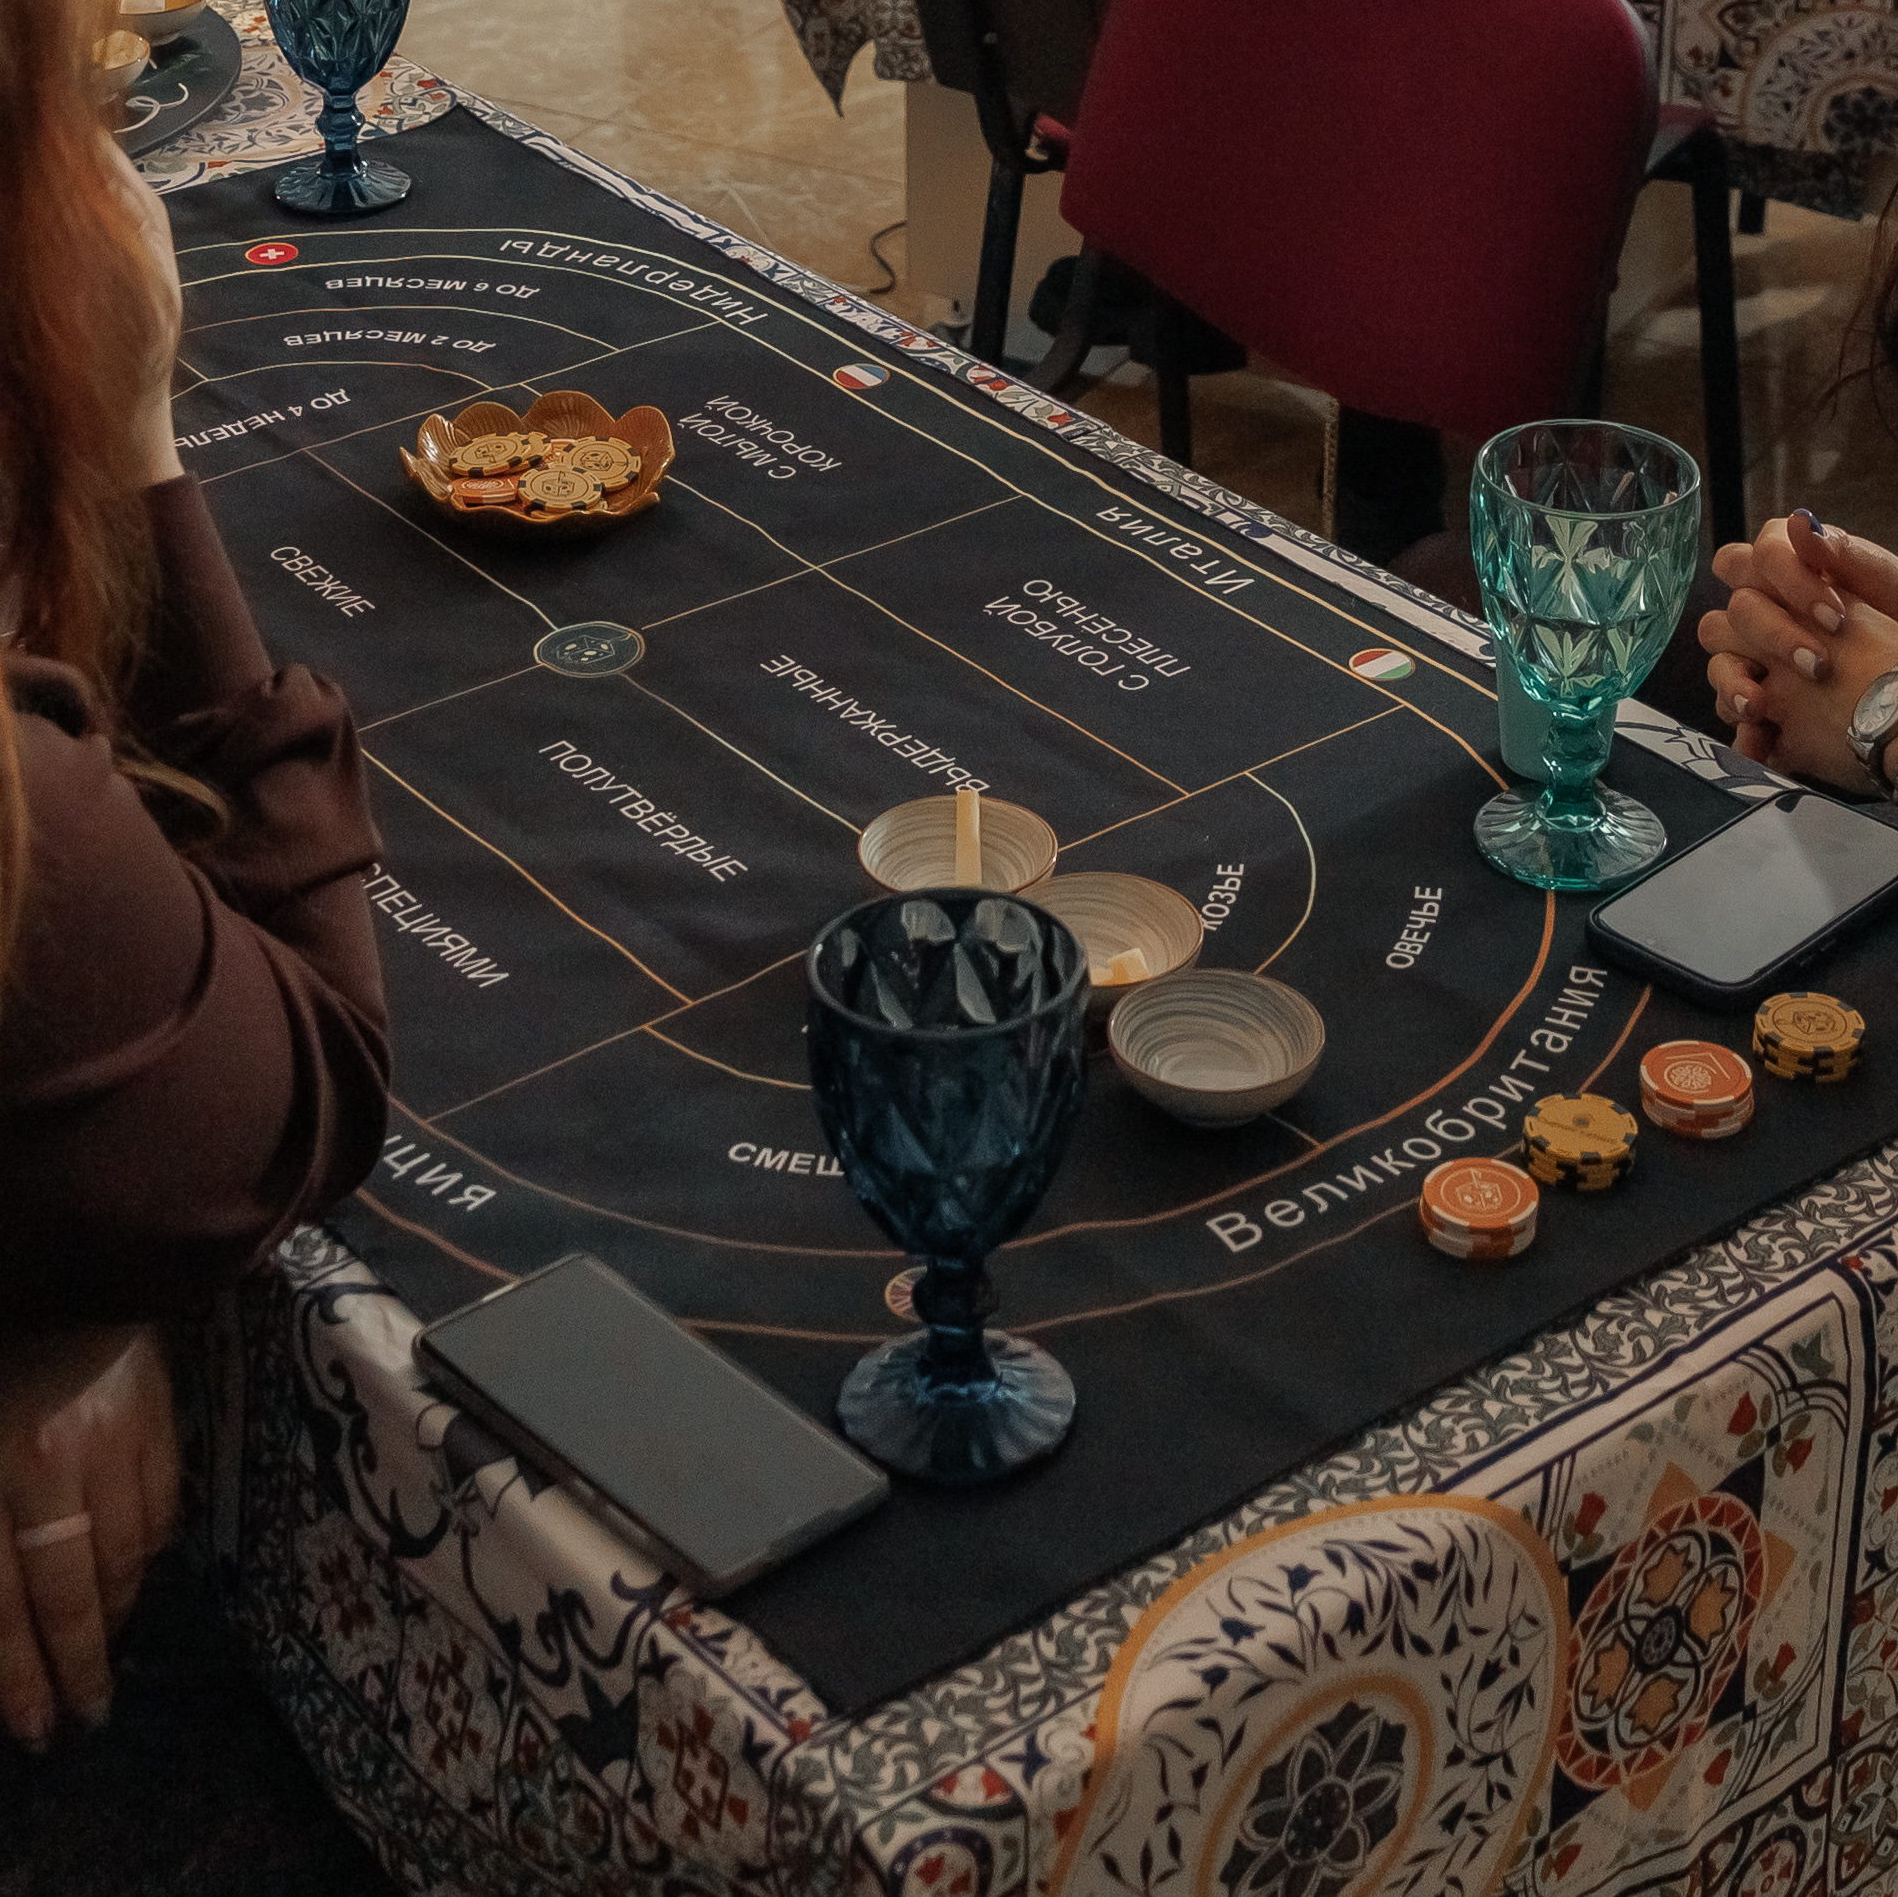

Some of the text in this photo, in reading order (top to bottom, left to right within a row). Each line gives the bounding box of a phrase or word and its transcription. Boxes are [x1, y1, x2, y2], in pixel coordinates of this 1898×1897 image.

[325, 275, 541, 299] ДО 6 МЕСЯЦЕВ
[499, 239, 769, 326] Нидерланды
[283, 330, 497, 353] ДО 2 МЕСЯЦЕВ
[173, 388, 351, 448] ДО 4 НЕДЕЛЬ
[676, 412, 797, 480] С МЫТОЙ
[704, 395, 843, 472] КОРОЧКОЙ
[270, 546, 376, 618] СВЕЖИЕ
[1096, 506, 1255, 594] Италия
[982, 596, 1150, 691] С ГОЛУБОЙ
[1022, 579, 1192, 678] ПЛЕСЕНЬЮ
[759, 654, 991, 793] ВЫДЕРЖАННЫЕ
[538, 740, 749, 883] ПОЛУТВЁРДЫЕ
[1385, 886, 1443, 970] ОВЕЧЬЕ
[1205, 965, 1609, 1254] Великобритания
